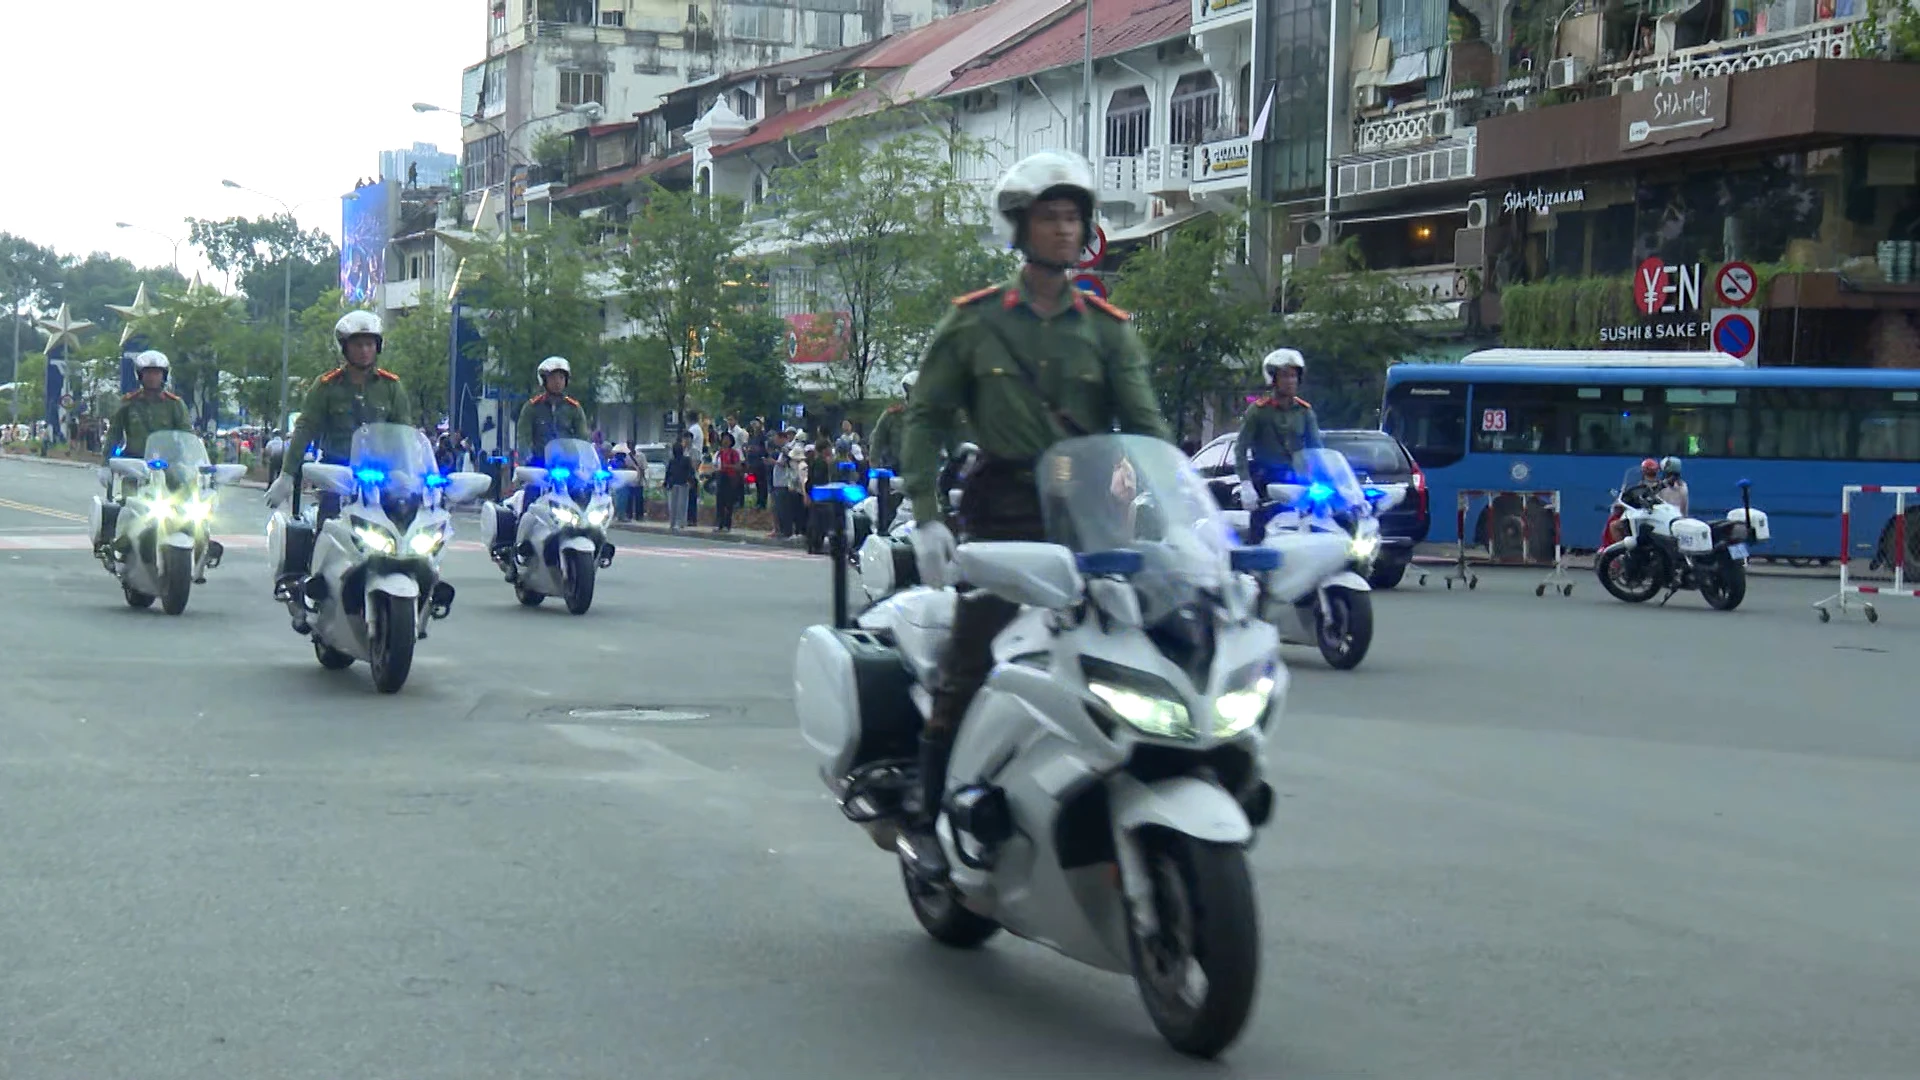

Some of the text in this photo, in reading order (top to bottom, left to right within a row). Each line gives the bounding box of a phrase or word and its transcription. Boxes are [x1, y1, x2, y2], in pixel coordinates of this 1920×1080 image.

[1600, 326, 1642, 341] SUSHI
[1644, 325, 1653, 338] &
[1655, 322, 1697, 338] SAKE
[1484, 411, 1504, 429] 93
